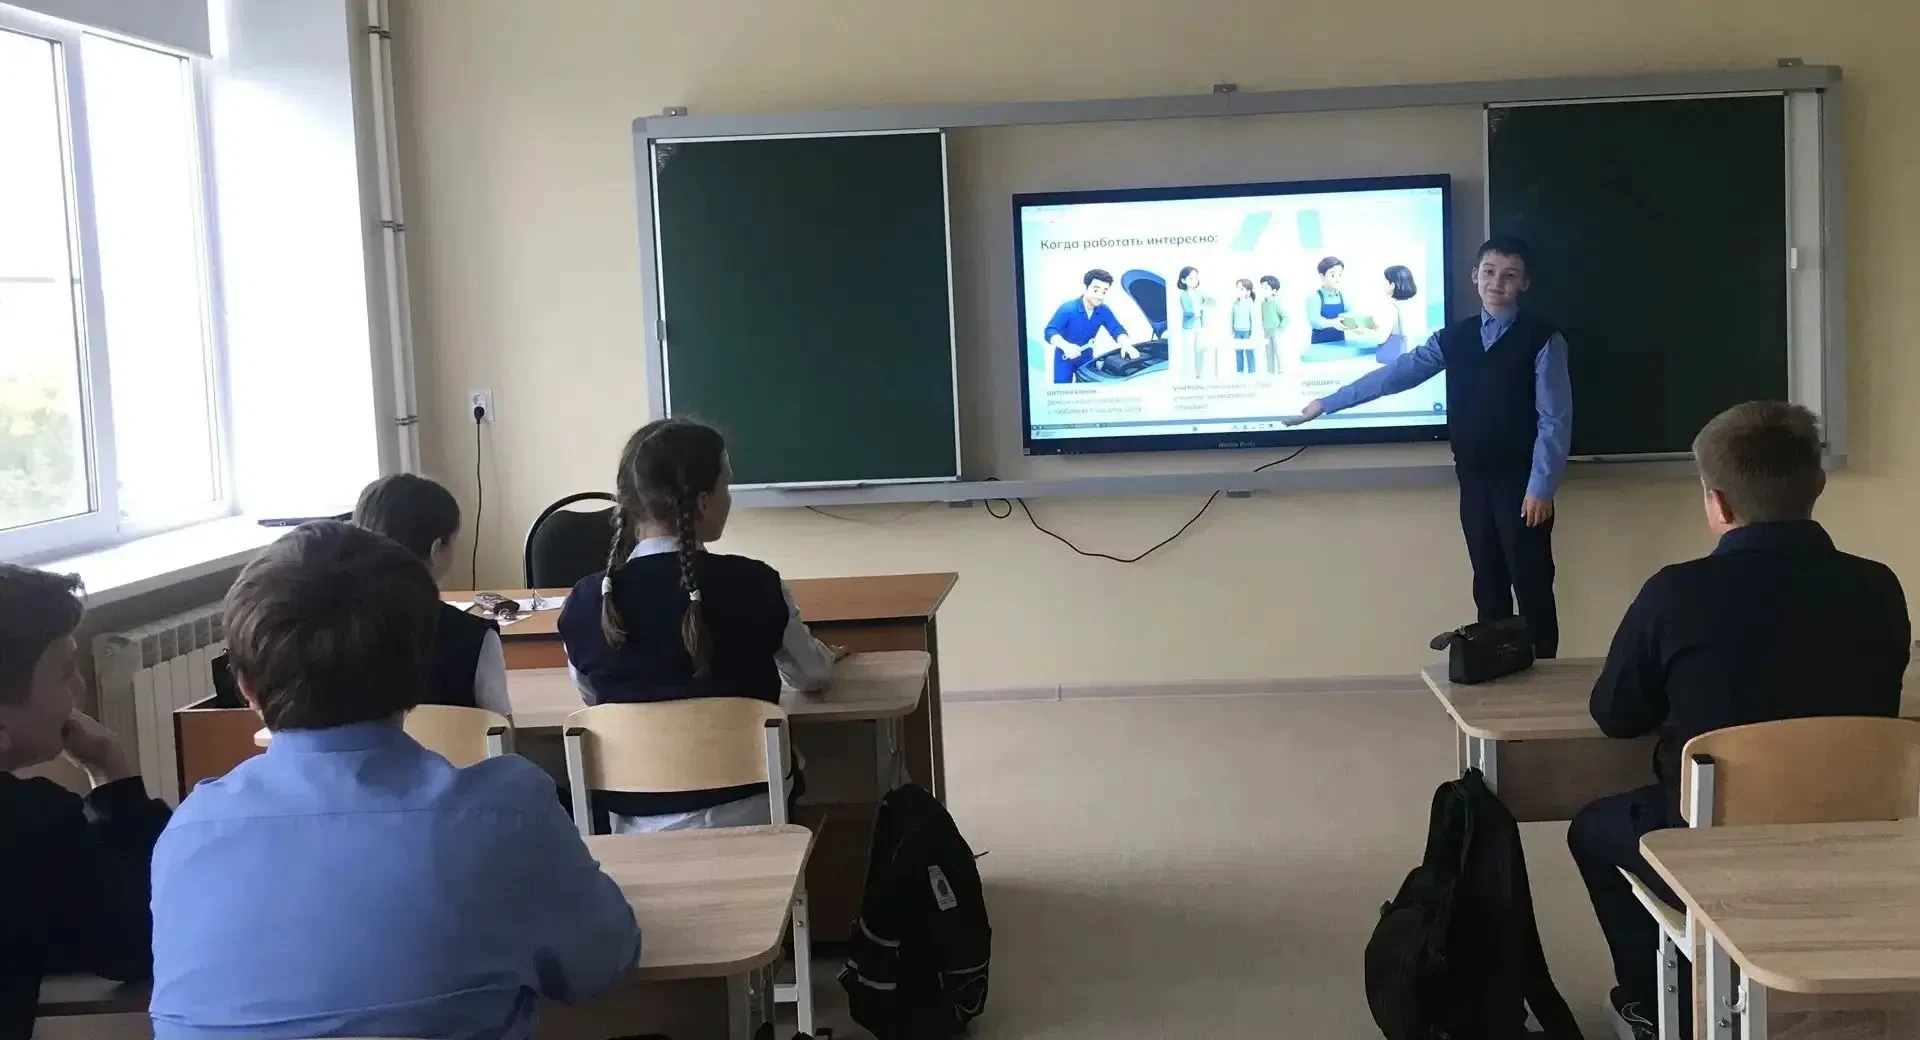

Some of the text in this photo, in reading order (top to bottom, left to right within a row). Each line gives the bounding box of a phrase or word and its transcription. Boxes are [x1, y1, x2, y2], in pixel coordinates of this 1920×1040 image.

[1040, 234, 1219, 250] Когда работать интересно:
